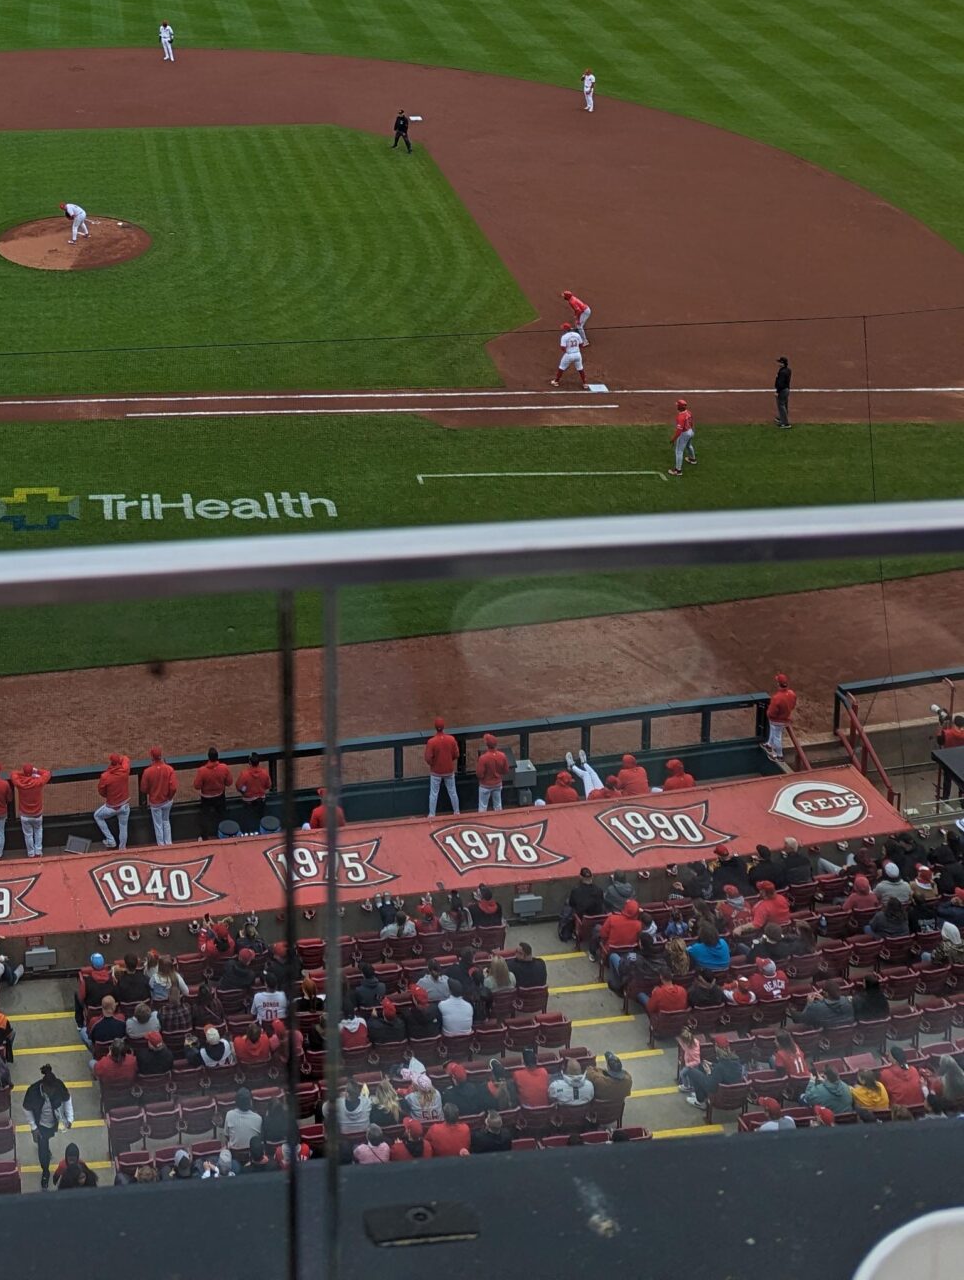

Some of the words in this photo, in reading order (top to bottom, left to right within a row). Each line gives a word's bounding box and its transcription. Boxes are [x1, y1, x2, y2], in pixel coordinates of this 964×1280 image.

[88, 492, 338, 520] TriHealth
[797, 794, 860, 813] REDS
[102, 863, 192, 905] 1940
[444, 825, 538, 862] 1976
[610, 803, 707, 844] 1990
[763, 980, 785, 992] BENCH
[794, 1059, 804, 1073] 11
